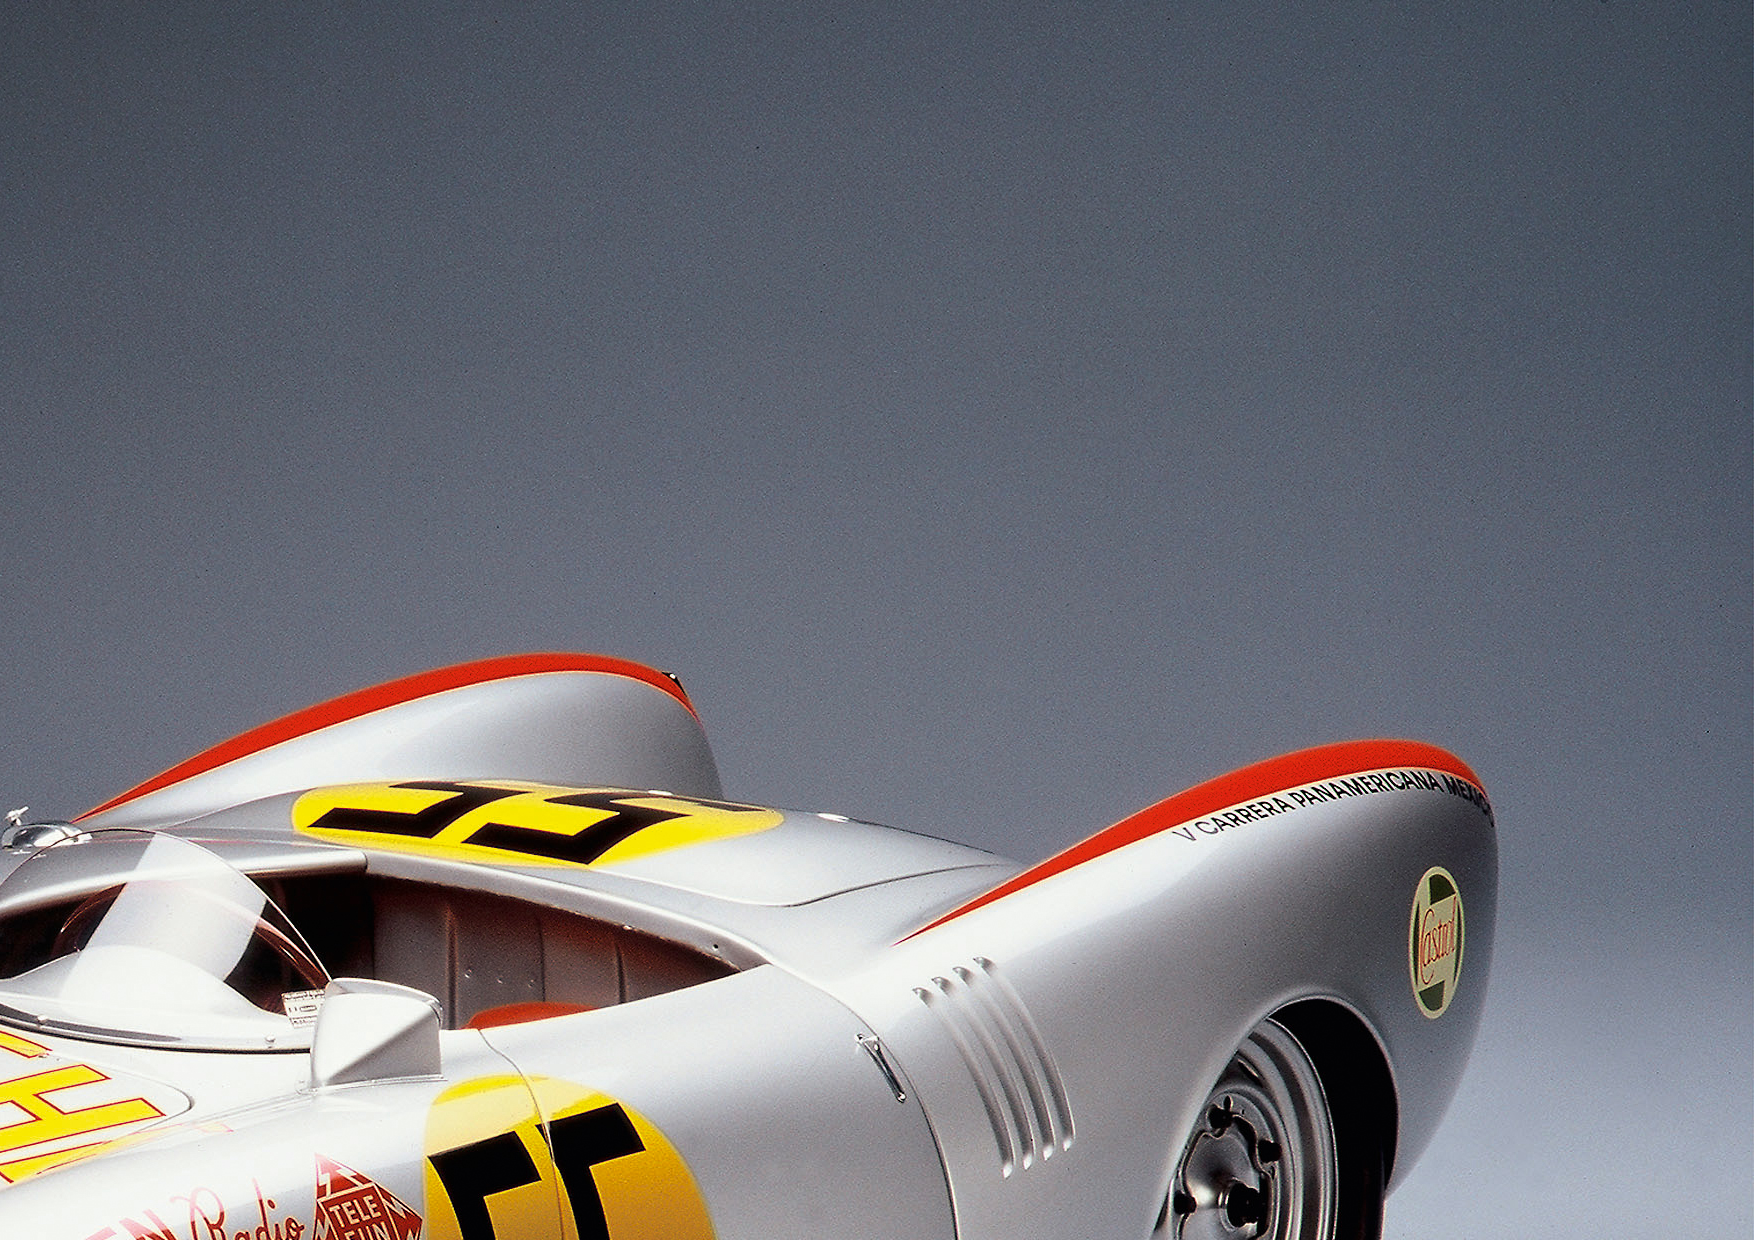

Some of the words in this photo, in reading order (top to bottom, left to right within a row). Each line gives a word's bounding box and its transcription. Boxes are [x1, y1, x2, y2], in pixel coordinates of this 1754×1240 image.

[1172, 828, 1197, 843] V
[1195, 797, 1296, 835] CARRERA
[1288, 770, 1445, 808] PANAMERICANA
[329, 1194, 382, 1228] TELE
